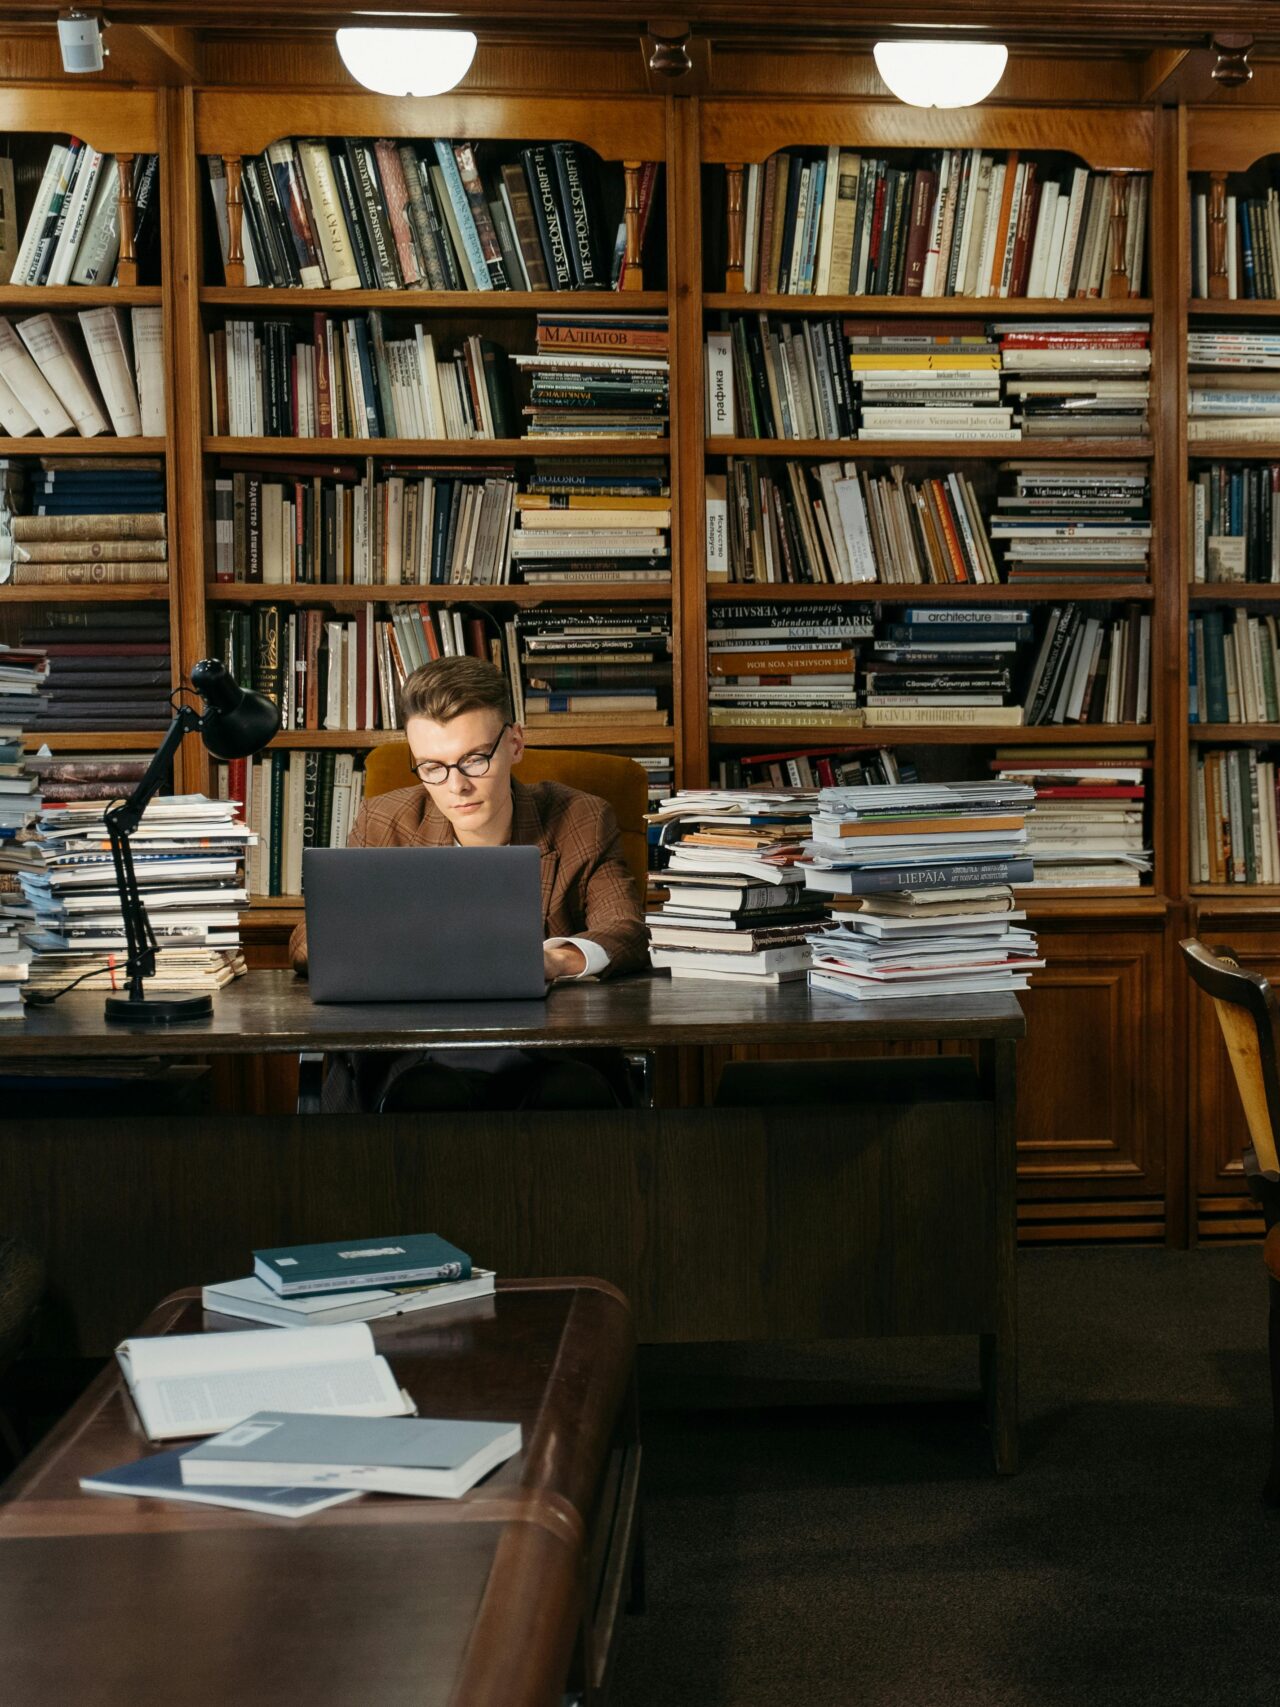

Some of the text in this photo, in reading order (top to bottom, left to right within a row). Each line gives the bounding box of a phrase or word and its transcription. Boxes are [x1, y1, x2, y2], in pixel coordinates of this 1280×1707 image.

[355, 148, 389, 267] ALTRUSSISCHE BAUKUNST
[546, 213, 564, 262] SCHÖNE
[28, 239, 45, 282] МАЛЕВИЧ
[556, 265, 569, 282] DIE
[582, 260, 594, 279] DIE
[538, 391, 591, 399] PANKIEWICZ
[715, 370, 726, 421] графика
[1202, 393, 1224, 402] Time
[1033, 488, 1079, 496] Afghanistan
[708, 516, 716, 556] Беларуси
[711, 606, 778, 618] VERSAILLES
[794, 604, 842, 614] Splendeurs
[771, 618, 820, 628] Splendeurs
[837, 616, 872, 626] PARIS
[928, 612, 992, 622] architecture
[788, 626, 868, 636] KOPENHAGEN
[747, 661, 766, 669] ROM
[787, 658, 832, 667] MOSAIKEN
[833, 658, 848, 666] DIE
[1038, 648, 1059, 696] Merveilleux
[1054, 634, 1064, 647] Art
[760, 718, 776, 726] LES
[897, 870, 946, 884] LIEPĀJA
